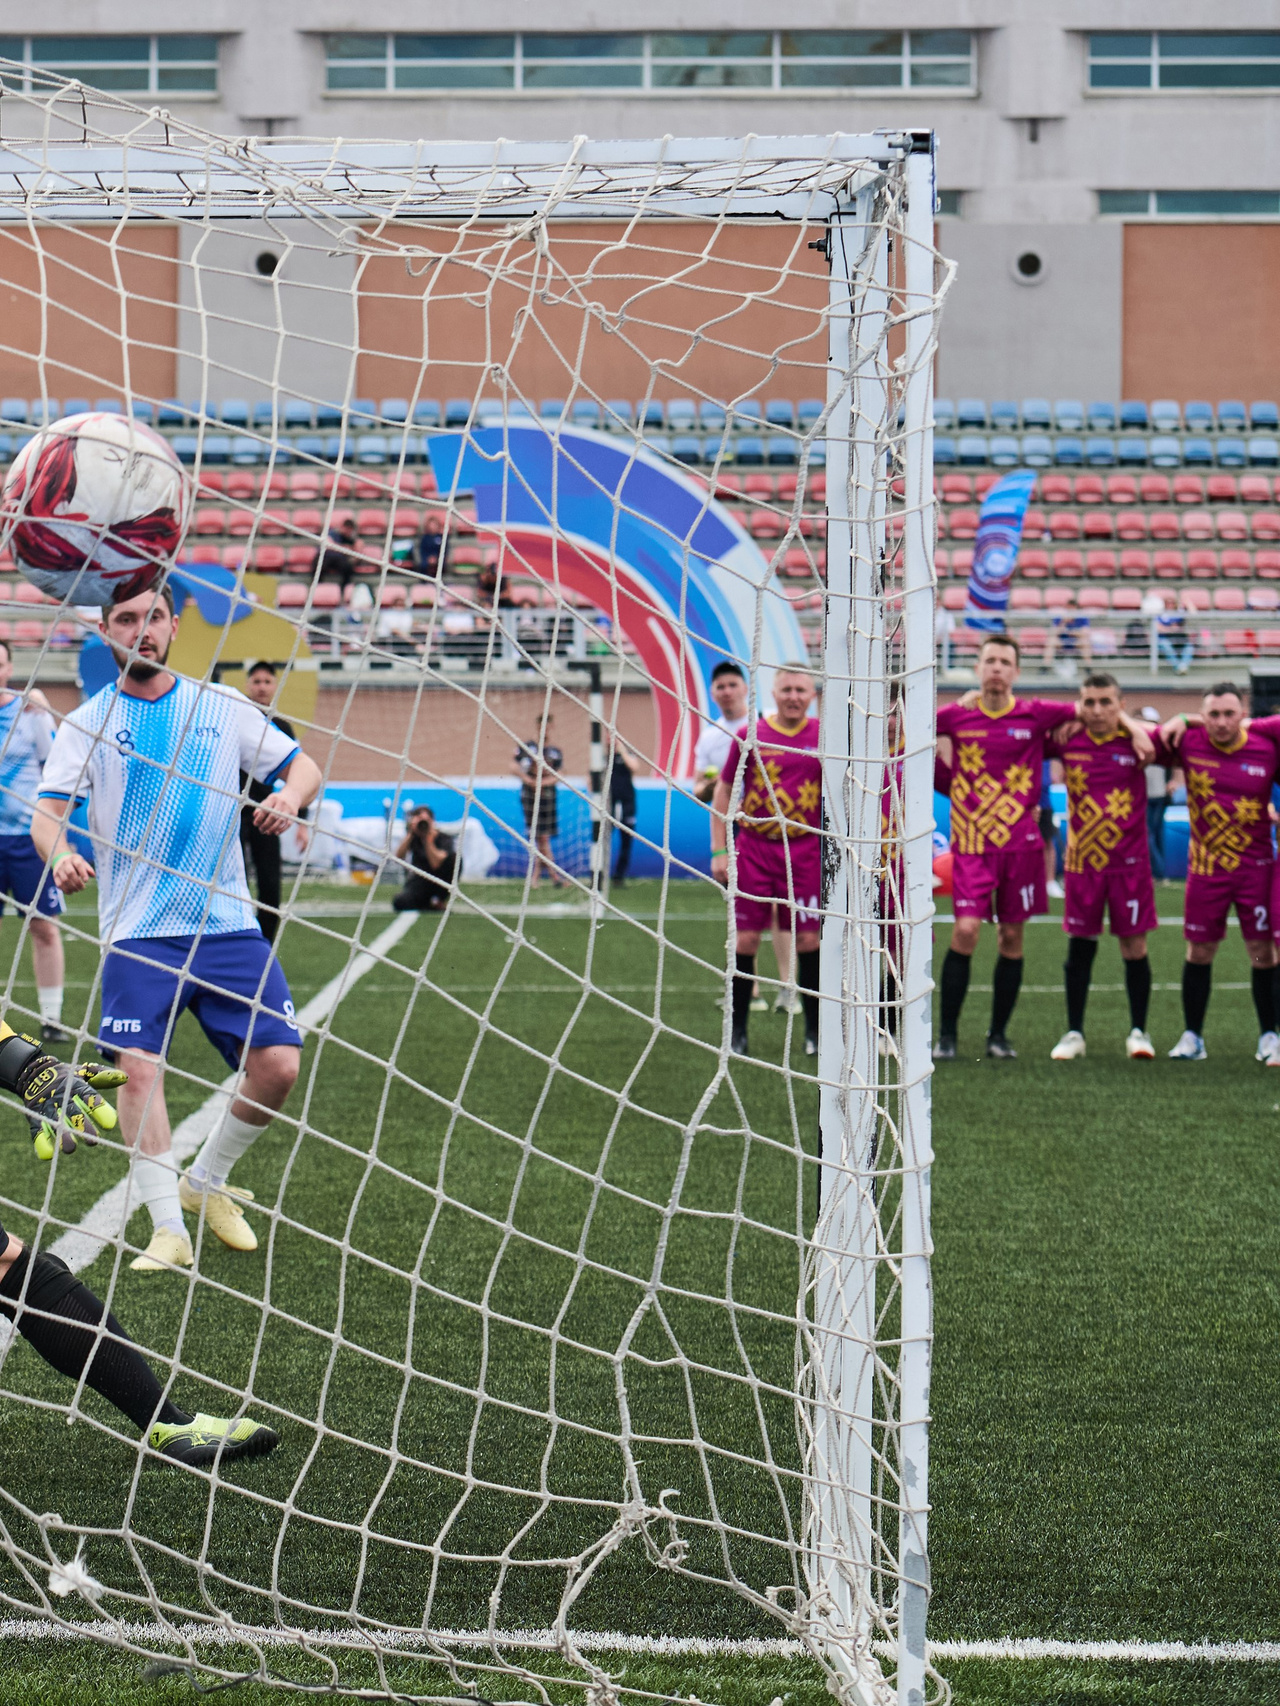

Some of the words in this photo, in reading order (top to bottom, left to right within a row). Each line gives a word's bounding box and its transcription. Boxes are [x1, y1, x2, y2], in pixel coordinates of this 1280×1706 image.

[115, 729, 135, 756] 8
[1126, 899, 1140, 927] 7
[1253, 905, 1268, 932] 2
[112, 1018, 142, 1034] ВТБ
[282, 999, 298, 1031] 8
